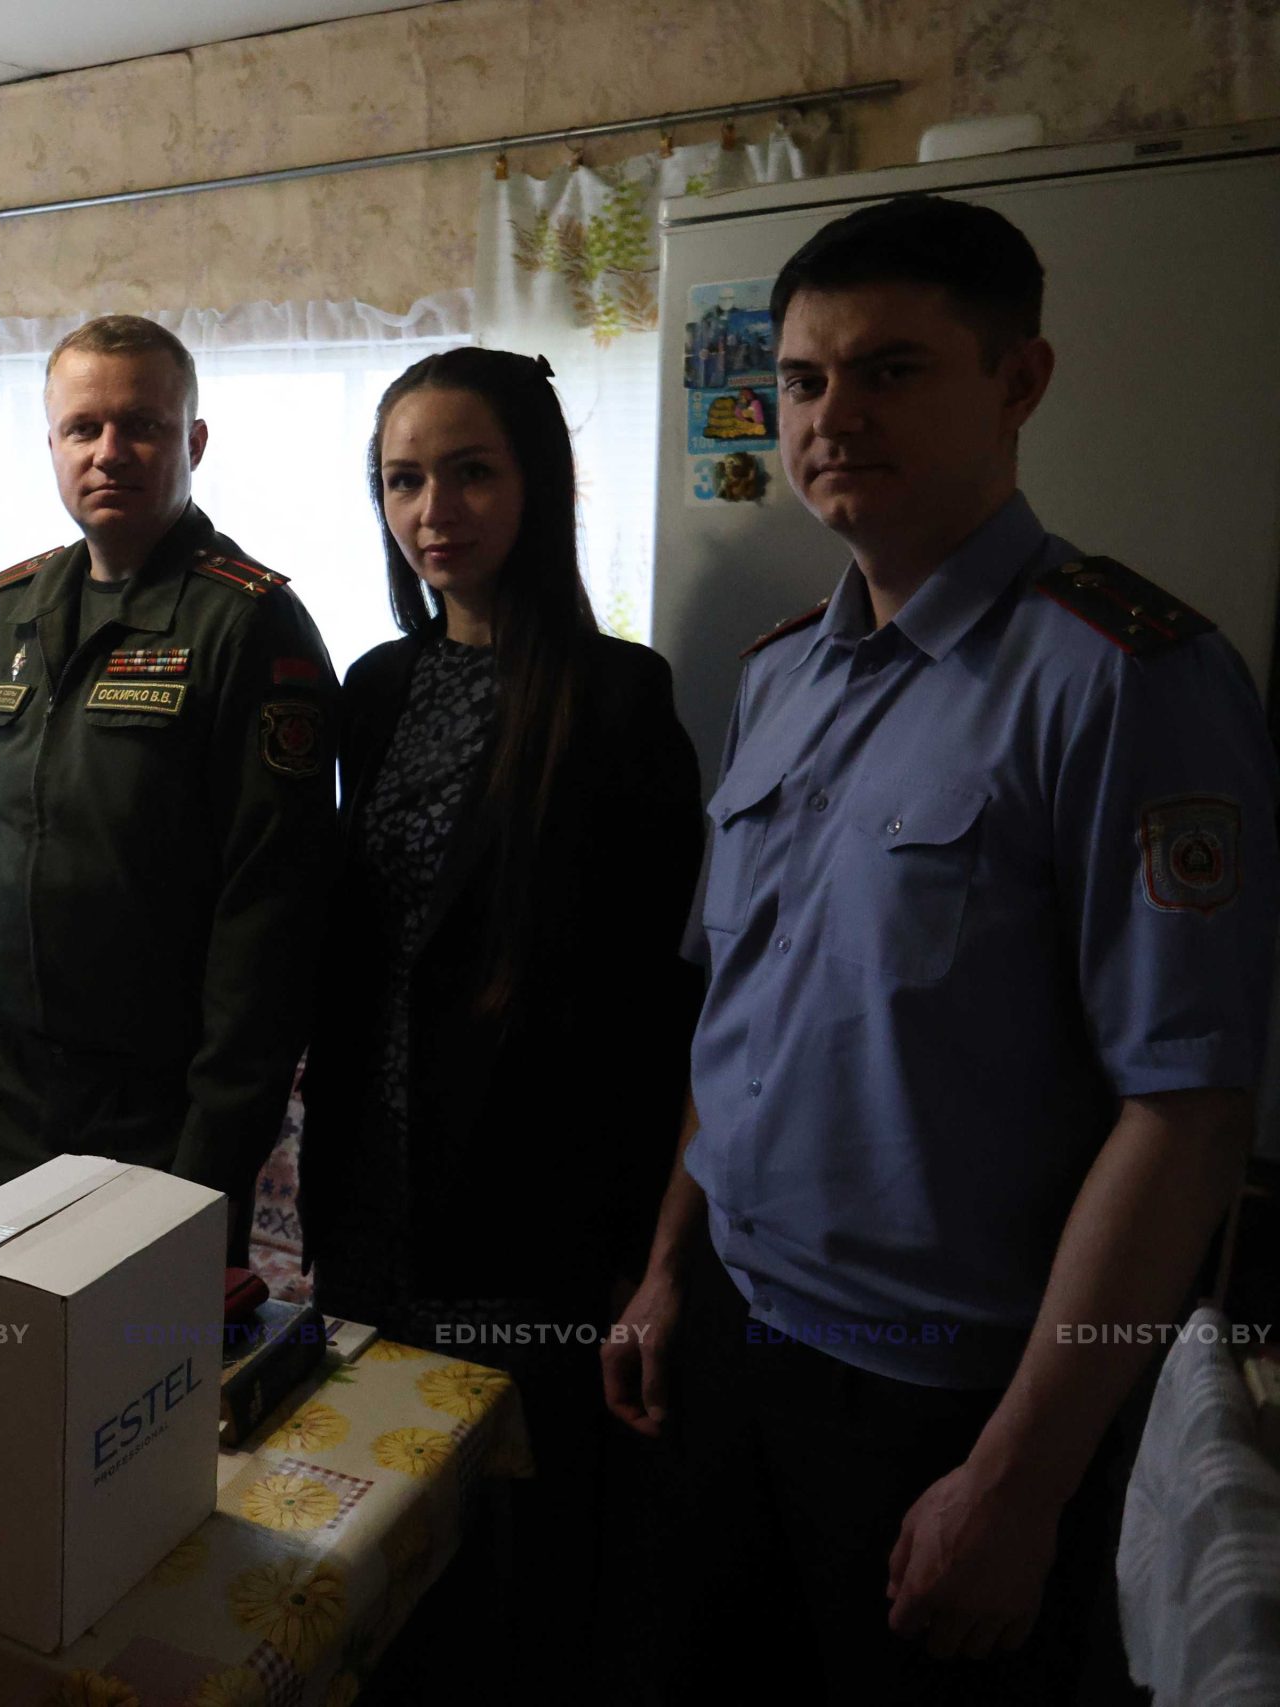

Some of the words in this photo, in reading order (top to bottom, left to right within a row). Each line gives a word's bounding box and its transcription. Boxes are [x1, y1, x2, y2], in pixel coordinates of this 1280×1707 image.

[97, 688, 150, 702] ОСКИРКО
[94, 1356, 202, 1470] ESTEL
[93, 1423, 170, 1487] PROFESSIONAL
